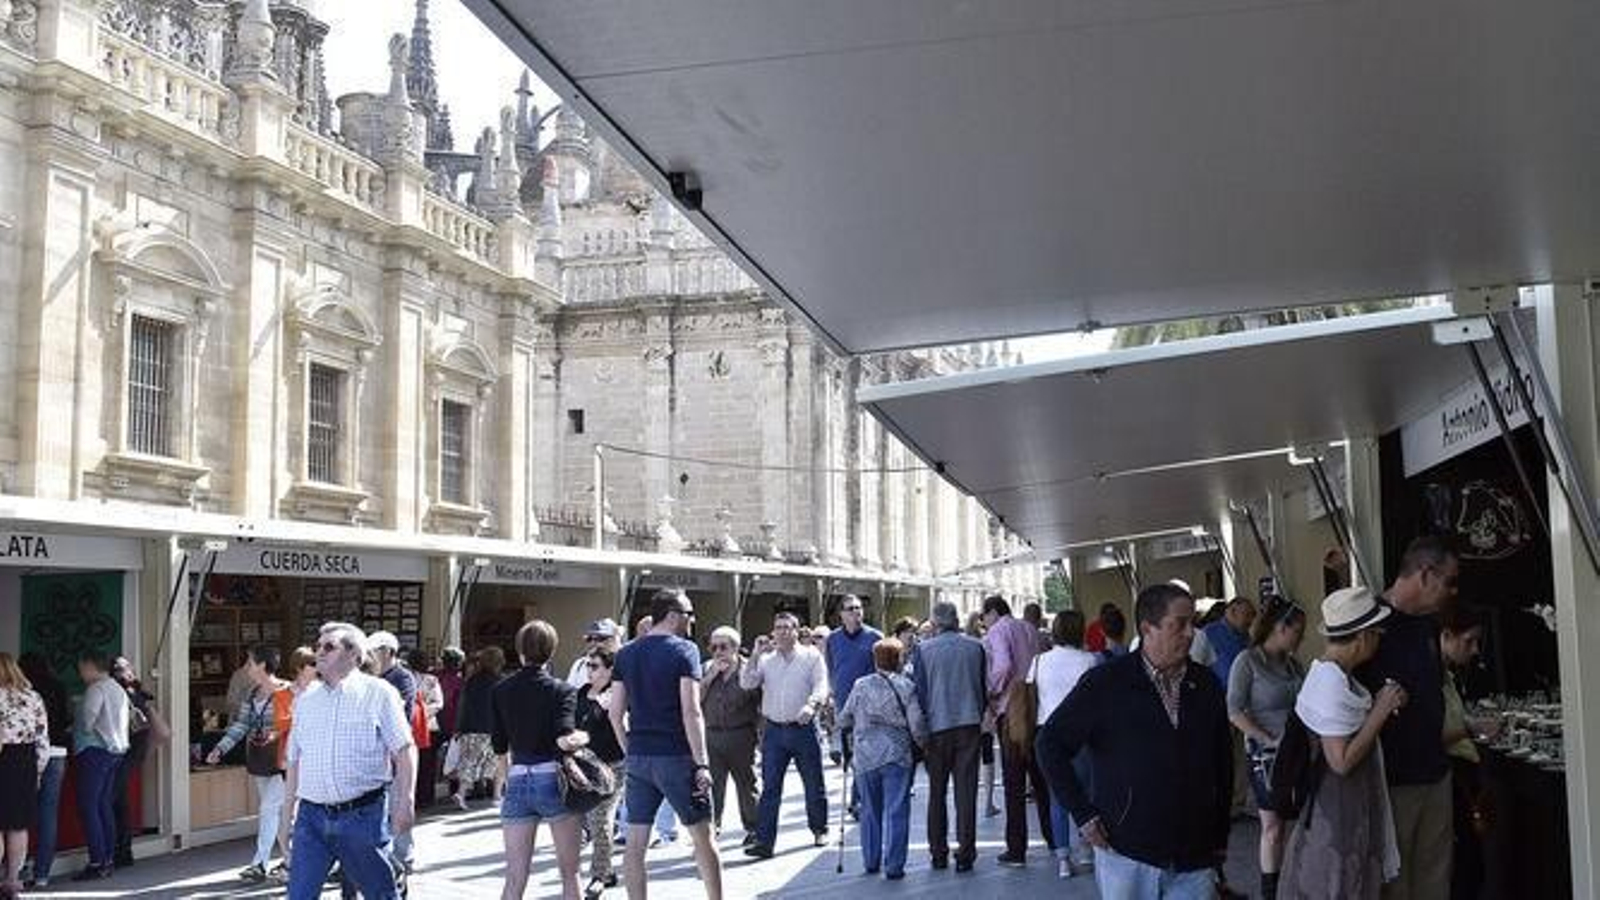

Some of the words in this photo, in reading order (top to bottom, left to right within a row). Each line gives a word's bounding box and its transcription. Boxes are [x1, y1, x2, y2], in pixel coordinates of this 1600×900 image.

[0, 535, 50, 558] ATA
[260, 550, 322, 572] CUERDA
[324, 555, 361, 574] SECA
